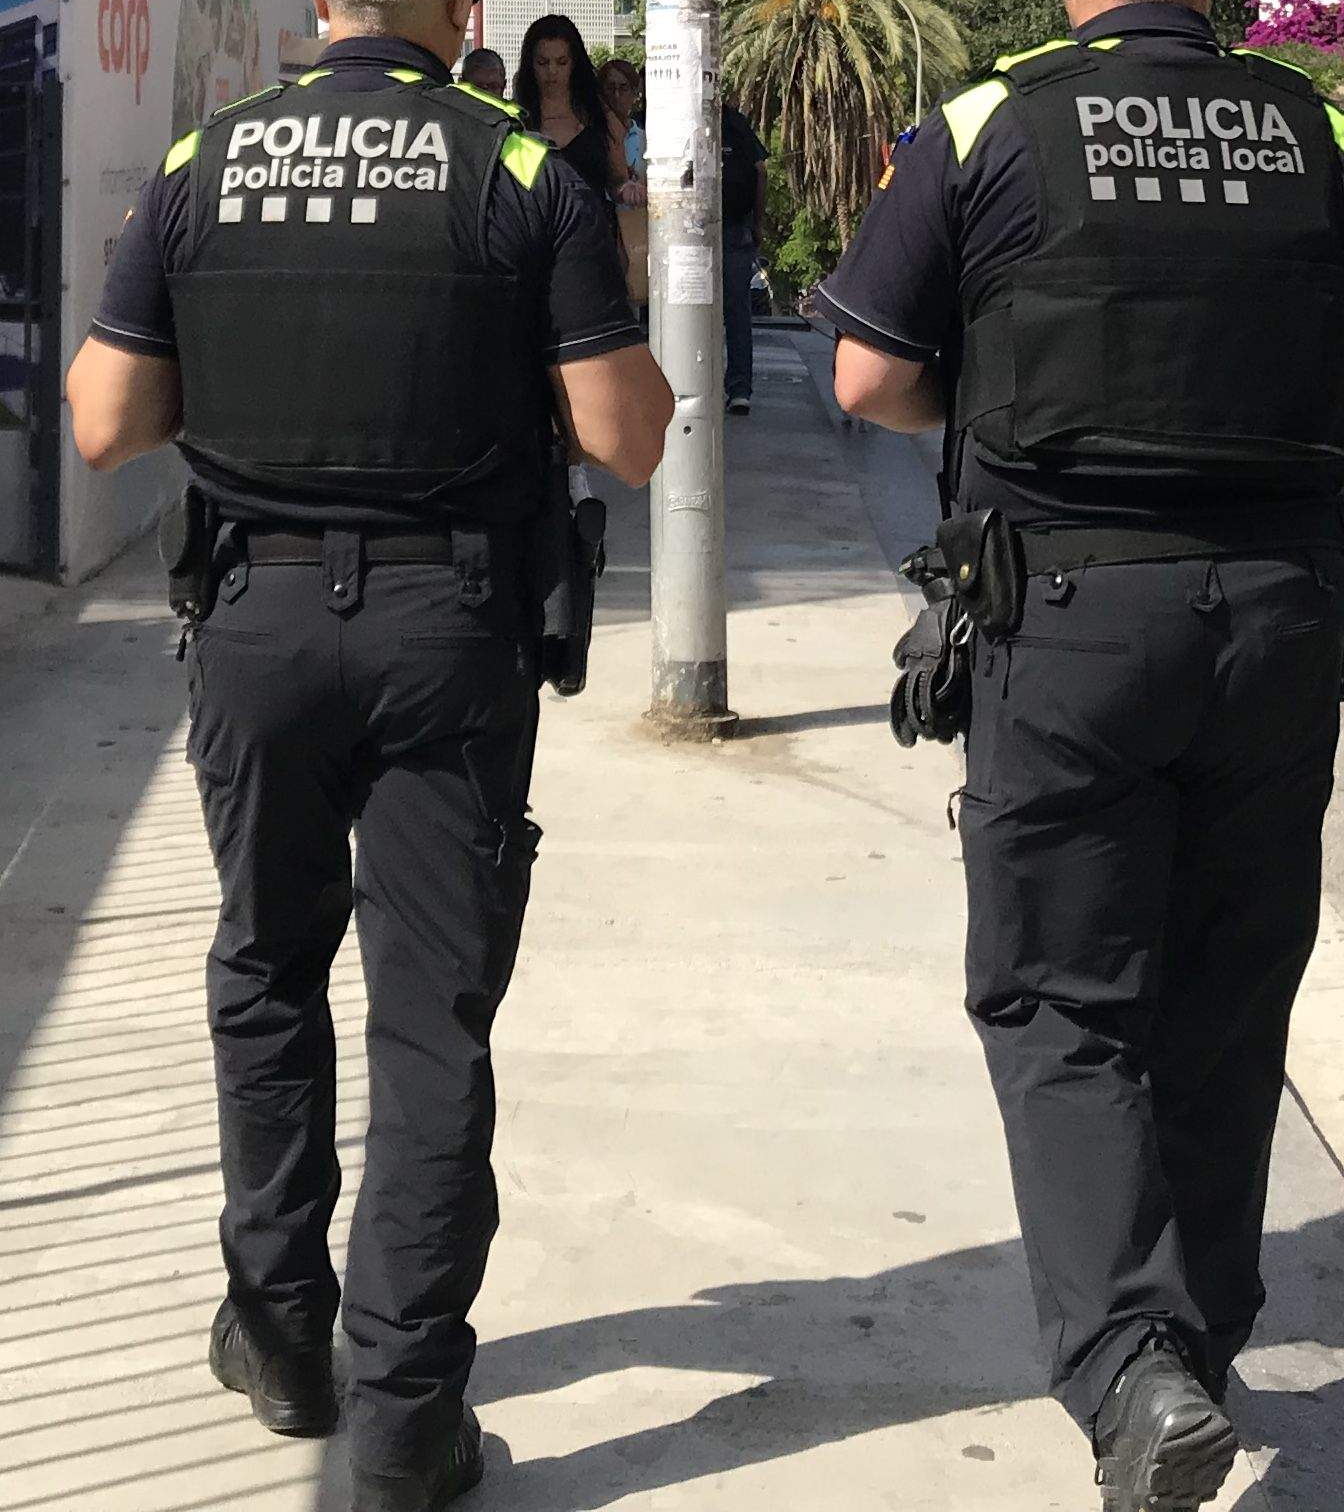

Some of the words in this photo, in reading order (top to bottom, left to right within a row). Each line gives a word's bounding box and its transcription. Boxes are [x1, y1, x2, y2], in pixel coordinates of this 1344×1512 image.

[226, 117, 449, 162] POLICIA
[1075, 96, 1299, 145] POLICIA
[220, 157, 345, 196] policia
[357, 159, 449, 192] local
[1084, 138, 1211, 173] policia
[1220, 140, 1305, 174] local
